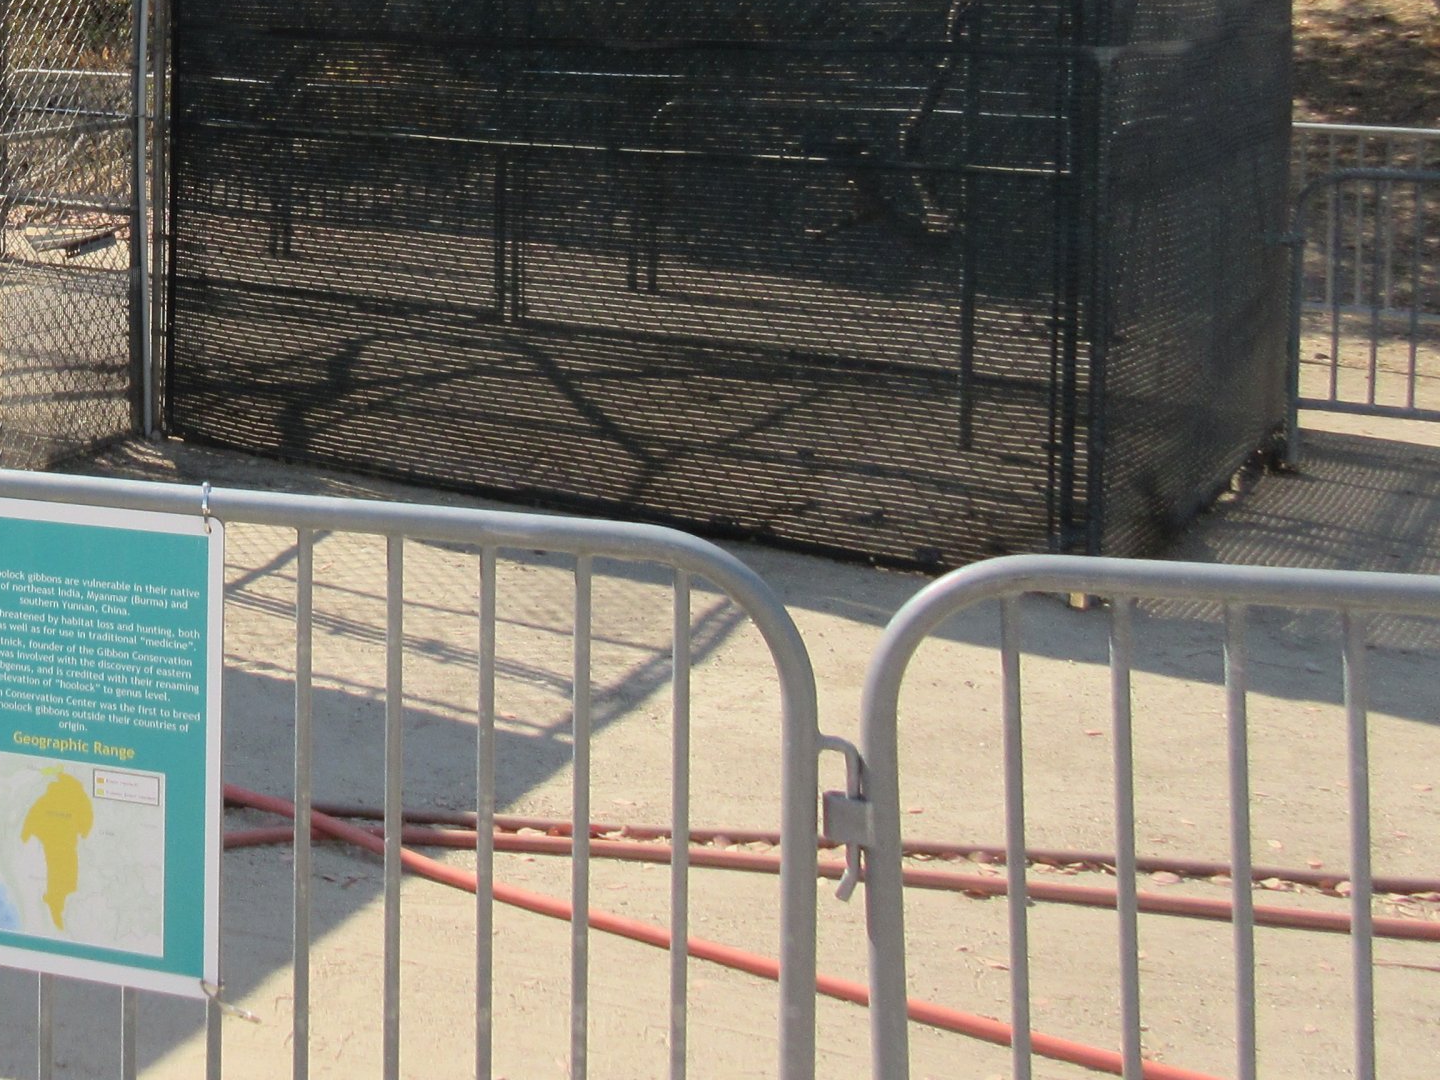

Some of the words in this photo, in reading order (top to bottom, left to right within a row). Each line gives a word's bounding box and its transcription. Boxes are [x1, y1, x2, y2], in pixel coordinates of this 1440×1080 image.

[0, 581, 9, 590] of
[12, 584, 54, 595] northeast
[86, 590, 127, 603] Myanmar
[131, 594, 167, 609] (Burma)
[171, 600, 188, 609] and
[28, 572, 62, 584] gibbons
[64, 578, 79, 586] are
[82, 578, 130, 591] vulnerable
[134, 583, 142, 592] in
[145, 584, 167, 595] their
[170, 588, 200, 598] native
[20, 598, 58, 608] southern
[101, 604, 130, 616] China.
[9, 623, 27, 632] well
[31, 626, 40, 634] as
[43, 625, 55, 635] for
[59, 629, 74, 637] use
[77, 629, 85, 638] in
[89, 631, 136, 644] traditional
[48, 614, 58, 626] by
[61, 615, 93, 628] habitat
[97, 619, 114, 630] loss
[117, 622, 133, 632] and
[178, 628, 200, 638] both
[17, 649, 54, 662] involved
[57, 655, 76, 665] with
[80, 657, 95, 667] the
[98, 659, 141, 674] discovery
[143, 665, 153, 674] of
[156, 668, 192, 679] eastern
[29, 639, 63, 651] founder
[66, 643, 75, 653] of
[79, 645, 94, 654] the
[97, 646, 129, 658] Gibbon
[132, 650, 192, 665] Conservation
[37, 666, 53, 675] and
[56, 666, 63, 676] is
[66, 670, 104, 681] credited
[107, 673, 127, 683] with
[130, 676, 152, 686] their
[156, 680, 200, 694] renaming
[42, 677, 51, 687] of
[103, 686, 113, 694] to
[115, 688, 142, 698] genus
[145, 689, 170, 701] level.
[5, 689, 63, 704] Conservation
[66, 696, 96, 708] Center
[100, 703, 116, 711] was
[120, 703, 135, 713] the
[138, 705, 156, 716] first
[160, 709, 170, 717] to
[173, 709, 200, 721] breed
[35, 704, 69, 717] gibbons
[72, 711, 105, 721] outside
[108, 714, 130, 724] their
[133, 719, 176, 730] countries
[179, 723, 189, 732] of
[59, 720, 88, 732] origin.
[13, 731, 89, 752] Geographic
[93, 741, 135, 760] Range
